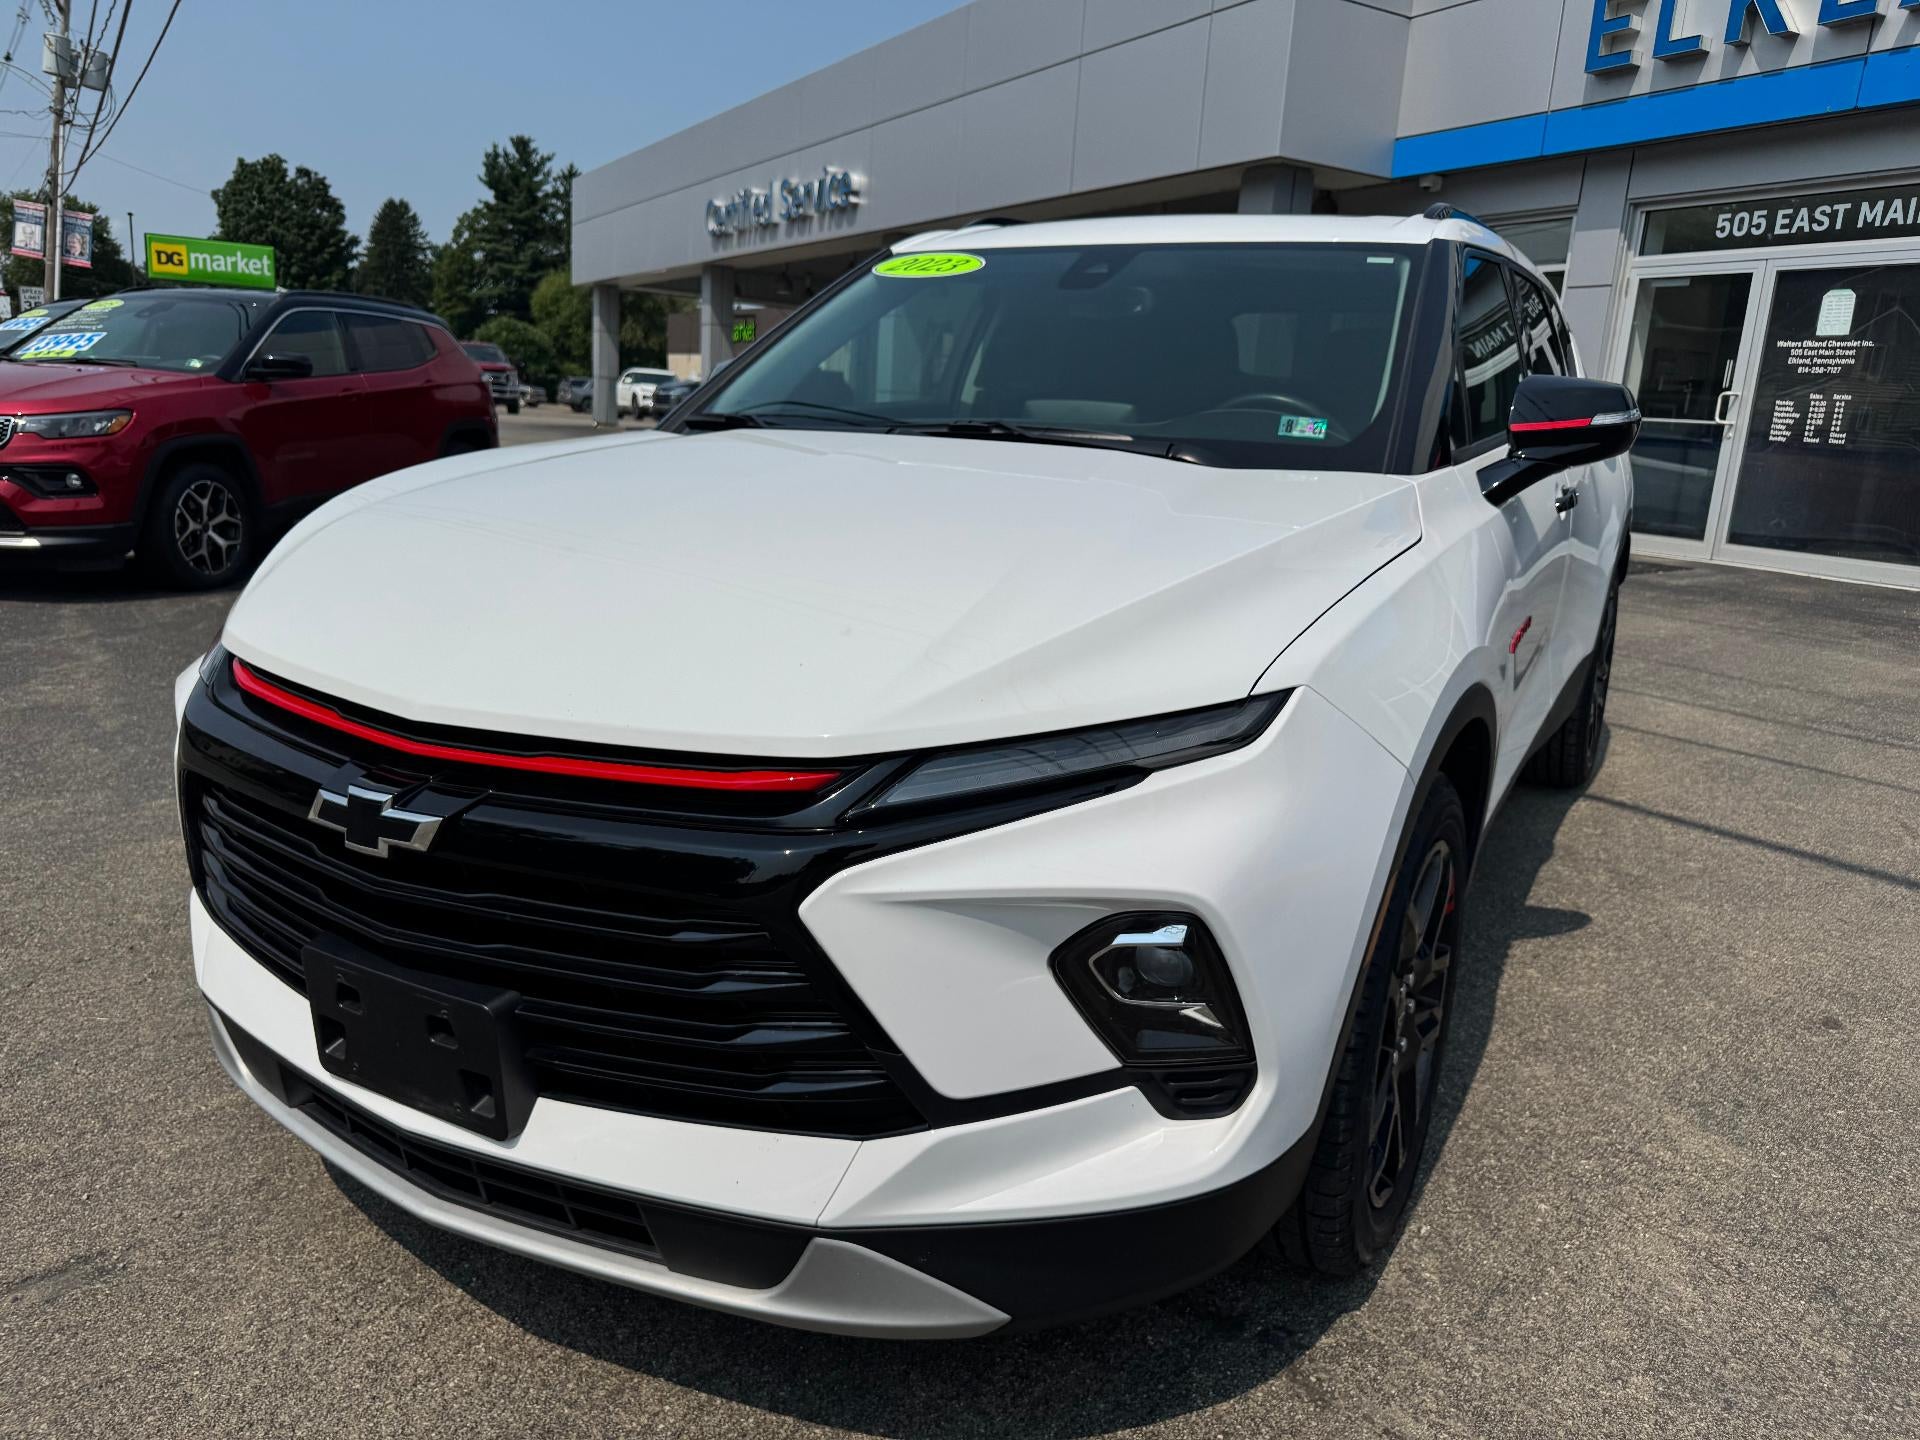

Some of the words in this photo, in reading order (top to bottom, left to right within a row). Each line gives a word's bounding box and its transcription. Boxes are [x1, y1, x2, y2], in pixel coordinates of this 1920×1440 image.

[1715, 210, 1768, 239] 505
[1774, 203, 1852, 235] EAST
[1856, 196, 1920, 229] MAI
[155, 250, 184, 267] DG
[190, 250, 271, 276] market
[883, 258, 971, 272] 2023
[1777, 340, 1802, 348] Walters
[1803, 340, 1828, 348] Elkland
[1828, 340, 1861, 348] Chevrolet
[1787, 357, 1812, 365] Elkland,
[1812, 357, 1856, 366] Pennsylvania
